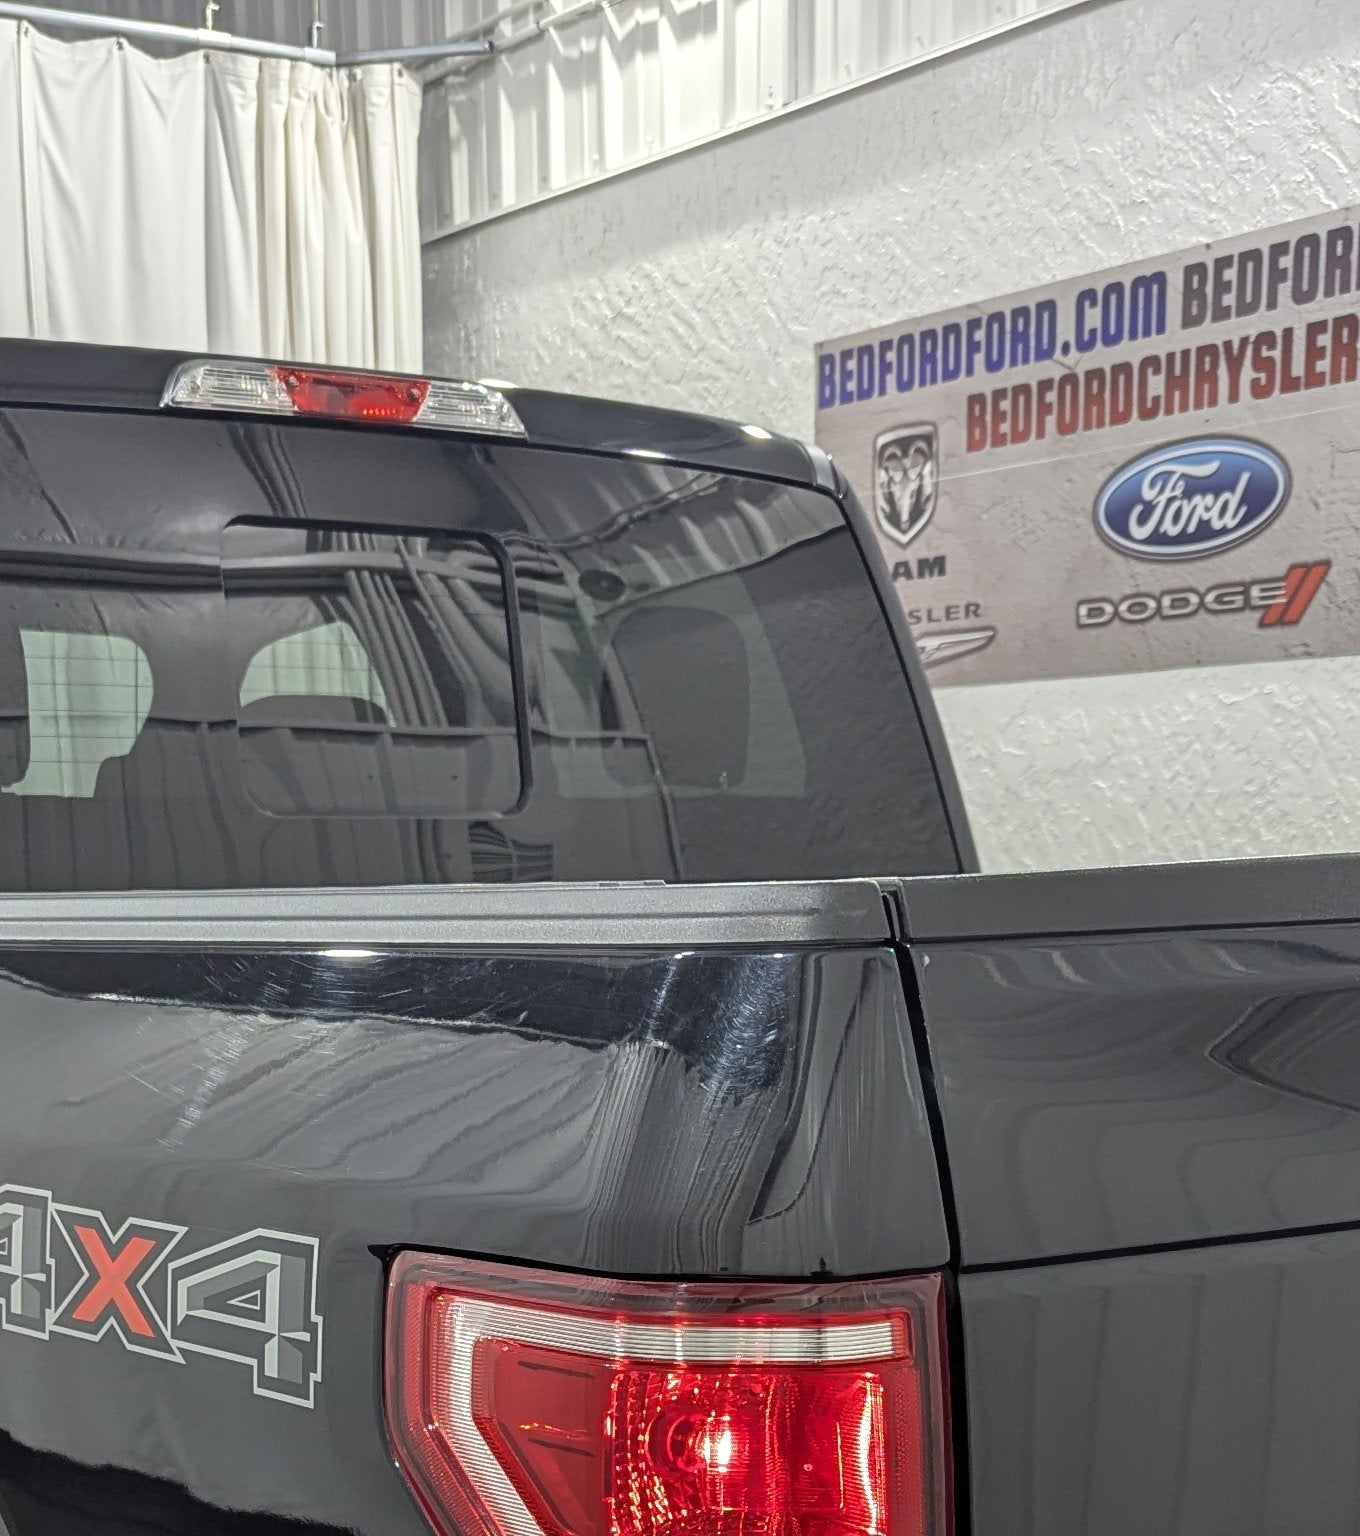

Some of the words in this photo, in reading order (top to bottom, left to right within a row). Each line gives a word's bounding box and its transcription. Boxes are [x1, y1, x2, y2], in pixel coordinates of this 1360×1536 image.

[818, 270, 1167, 411] BEDFORDFORD.COM
[1128, 460, 1252, 541] Ford
[891, 555, 947, 582] AM
[907, 602, 982, 626] SLER
[1076, 576, 1288, 629] DODGE
